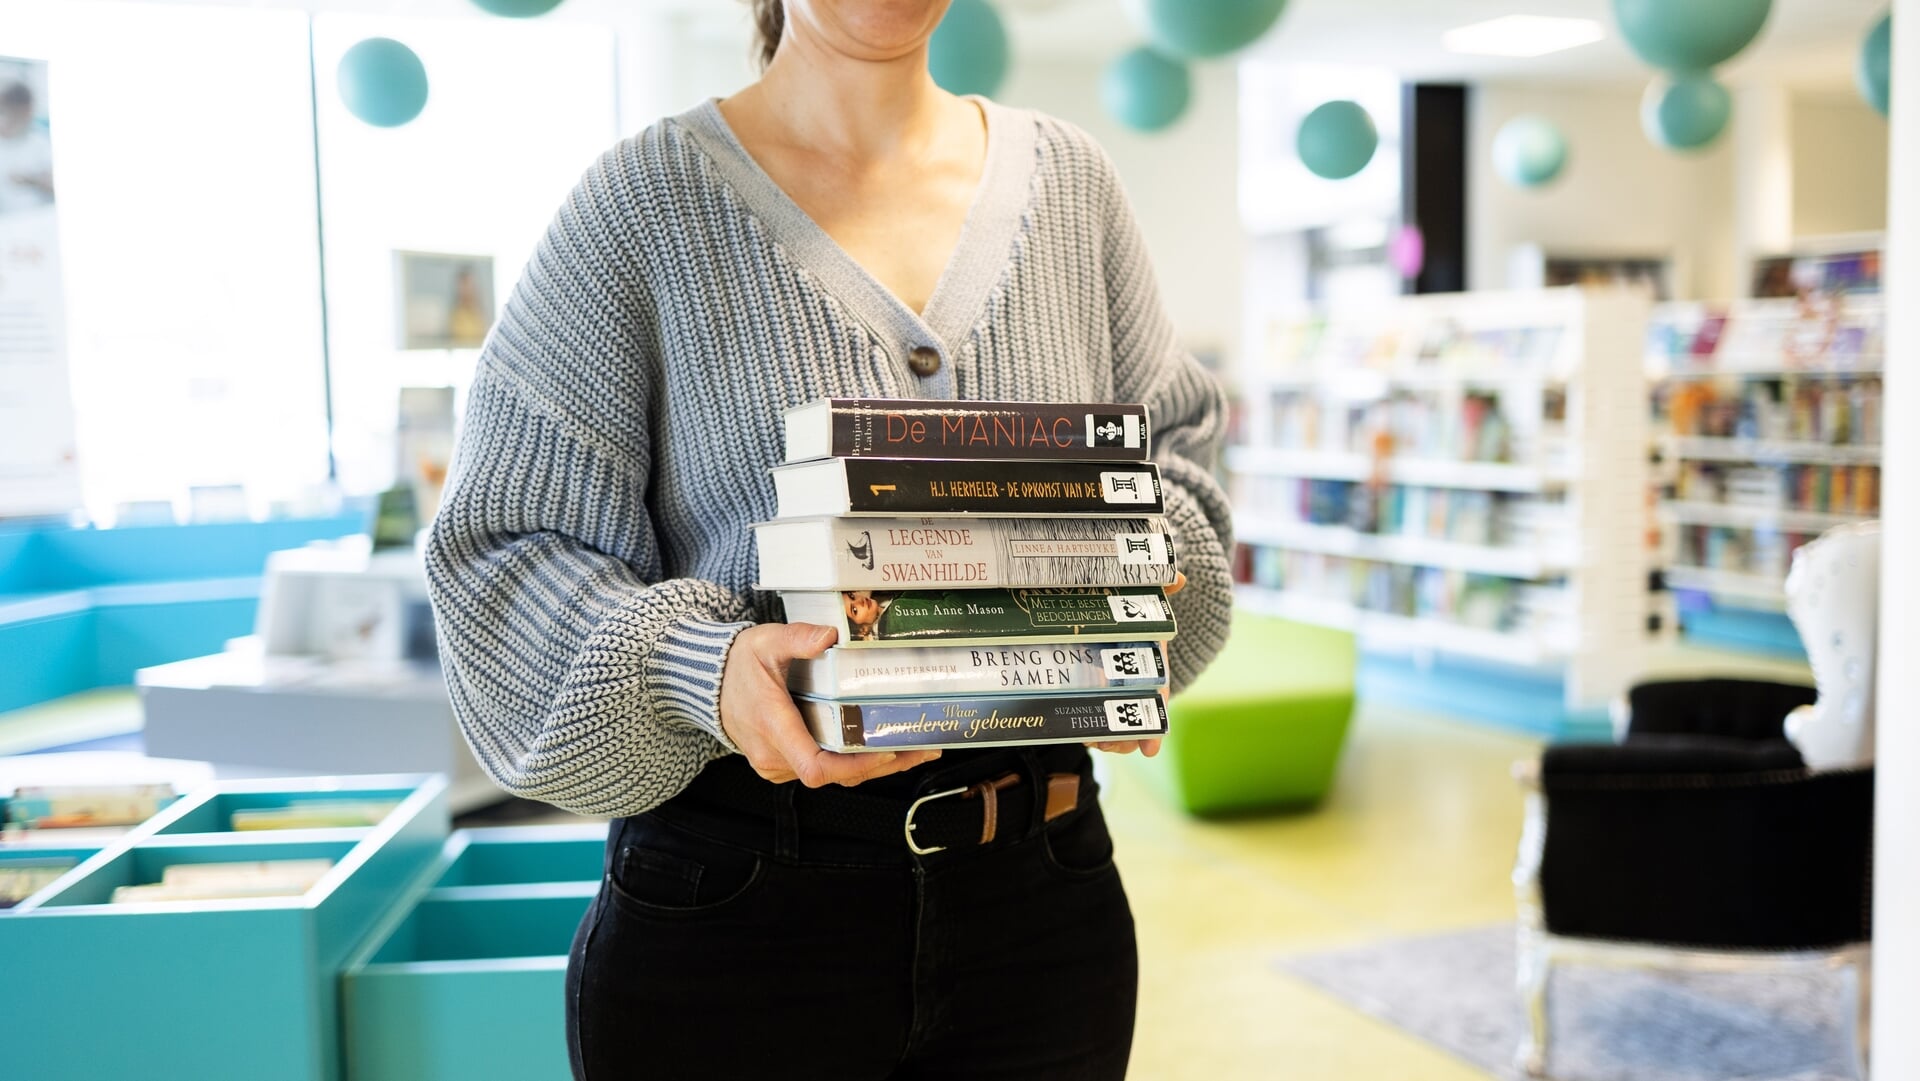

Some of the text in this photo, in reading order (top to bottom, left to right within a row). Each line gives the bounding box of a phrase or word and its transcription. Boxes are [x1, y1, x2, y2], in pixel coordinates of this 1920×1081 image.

[887, 413, 1072, 448] De MANIAC
[870, 484, 896, 496] 1
[930, 481, 948, 497] H.J.
[950, 481, 999, 497] HERMELER
[1007, 482, 1020, 498] DE
[1021, 482, 1061, 498] OPKOMST
[1062, 482, 1083, 498] VAN
[1084, 482, 1096, 498] DE
[888, 529, 973, 546] LEGENDE
[925, 549, 943, 559] VAN
[1014, 543, 1118, 554] LINNEA HARTSUYKE
[882, 563, 988, 582] SWANHILDE
[894, 603, 1005, 616] Susan Anne Mason
[1030, 597, 1109, 609] MET DE BESTE
[1036, 610, 1111, 622] BEDOELINGEN
[970, 649, 1093, 667] BRENG ONS
[1001, 668, 1071, 686] SAMEN
[942, 704, 978, 718] Waar
[1054, 705, 1093, 715] SUZANNE
[875, 709, 1046, 739] wonderen gebeuren
